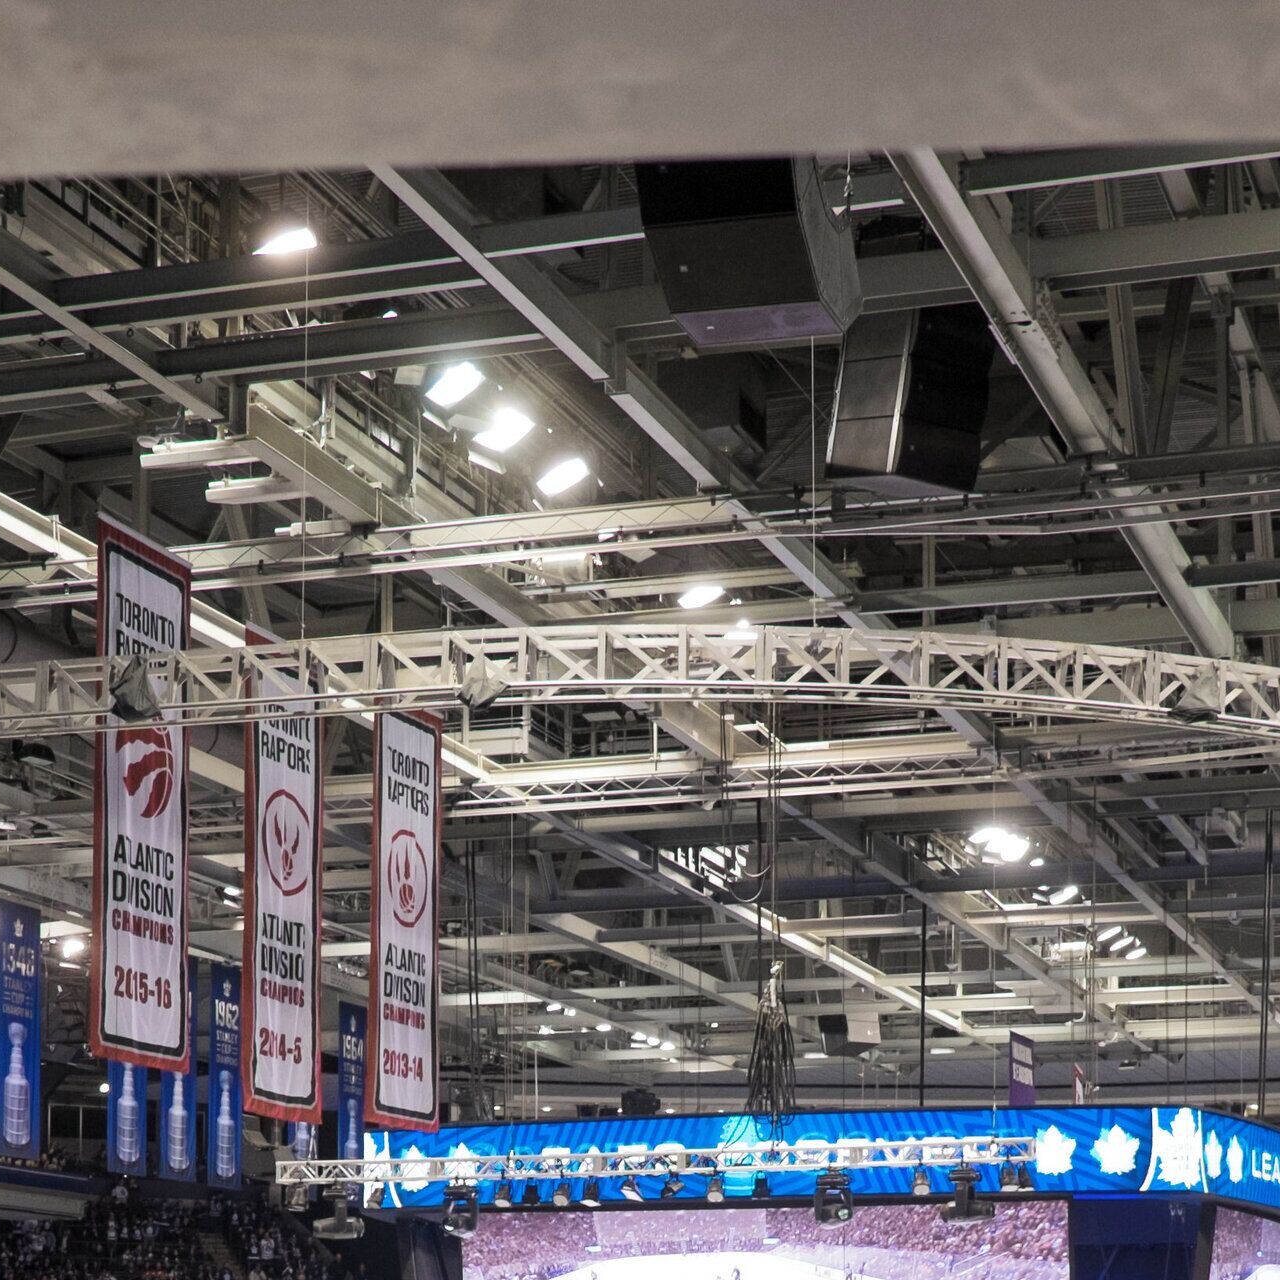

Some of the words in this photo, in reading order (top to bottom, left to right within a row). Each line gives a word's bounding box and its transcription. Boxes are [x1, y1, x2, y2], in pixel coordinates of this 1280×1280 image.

[116, 592, 174, 649] TORONTO
[114, 834, 174, 881] ATLANTIC
[112, 870, 173, 918] DVISION
[112, 909, 174, 946] CHMPIONS
[11, 992, 25, 1005] CUP
[114, 965, 172, 1009] 2015-16
[215, 999, 239, 1030] 1962
[342, 1034, 363, 1060] 1964
[383, 1049, 423, 1081] 2013-14
